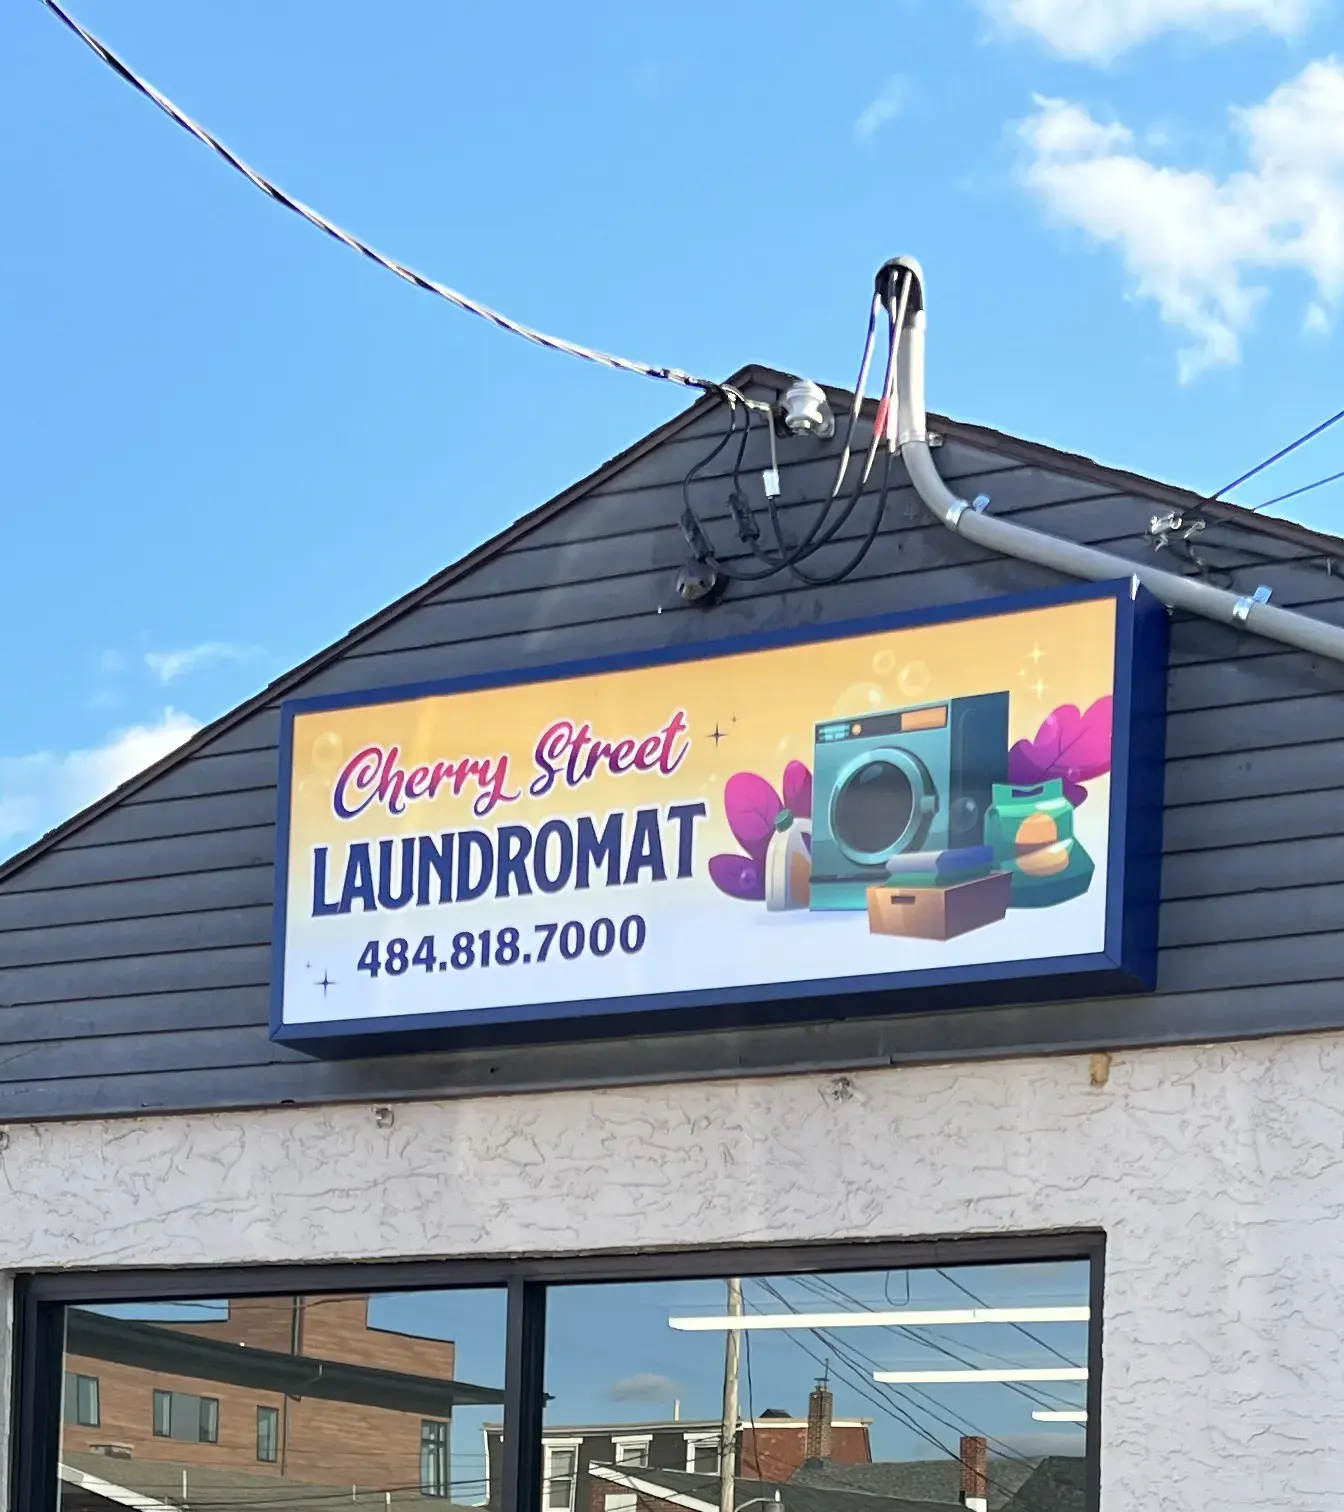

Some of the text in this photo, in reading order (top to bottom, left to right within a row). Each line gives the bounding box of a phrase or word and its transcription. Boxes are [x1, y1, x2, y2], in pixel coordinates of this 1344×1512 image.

[332, 710, 690, 819] Cherry Street
[311, 801, 707, 918] LAUNDROMAT
[356, 914, 647, 978] 484.818.7000
